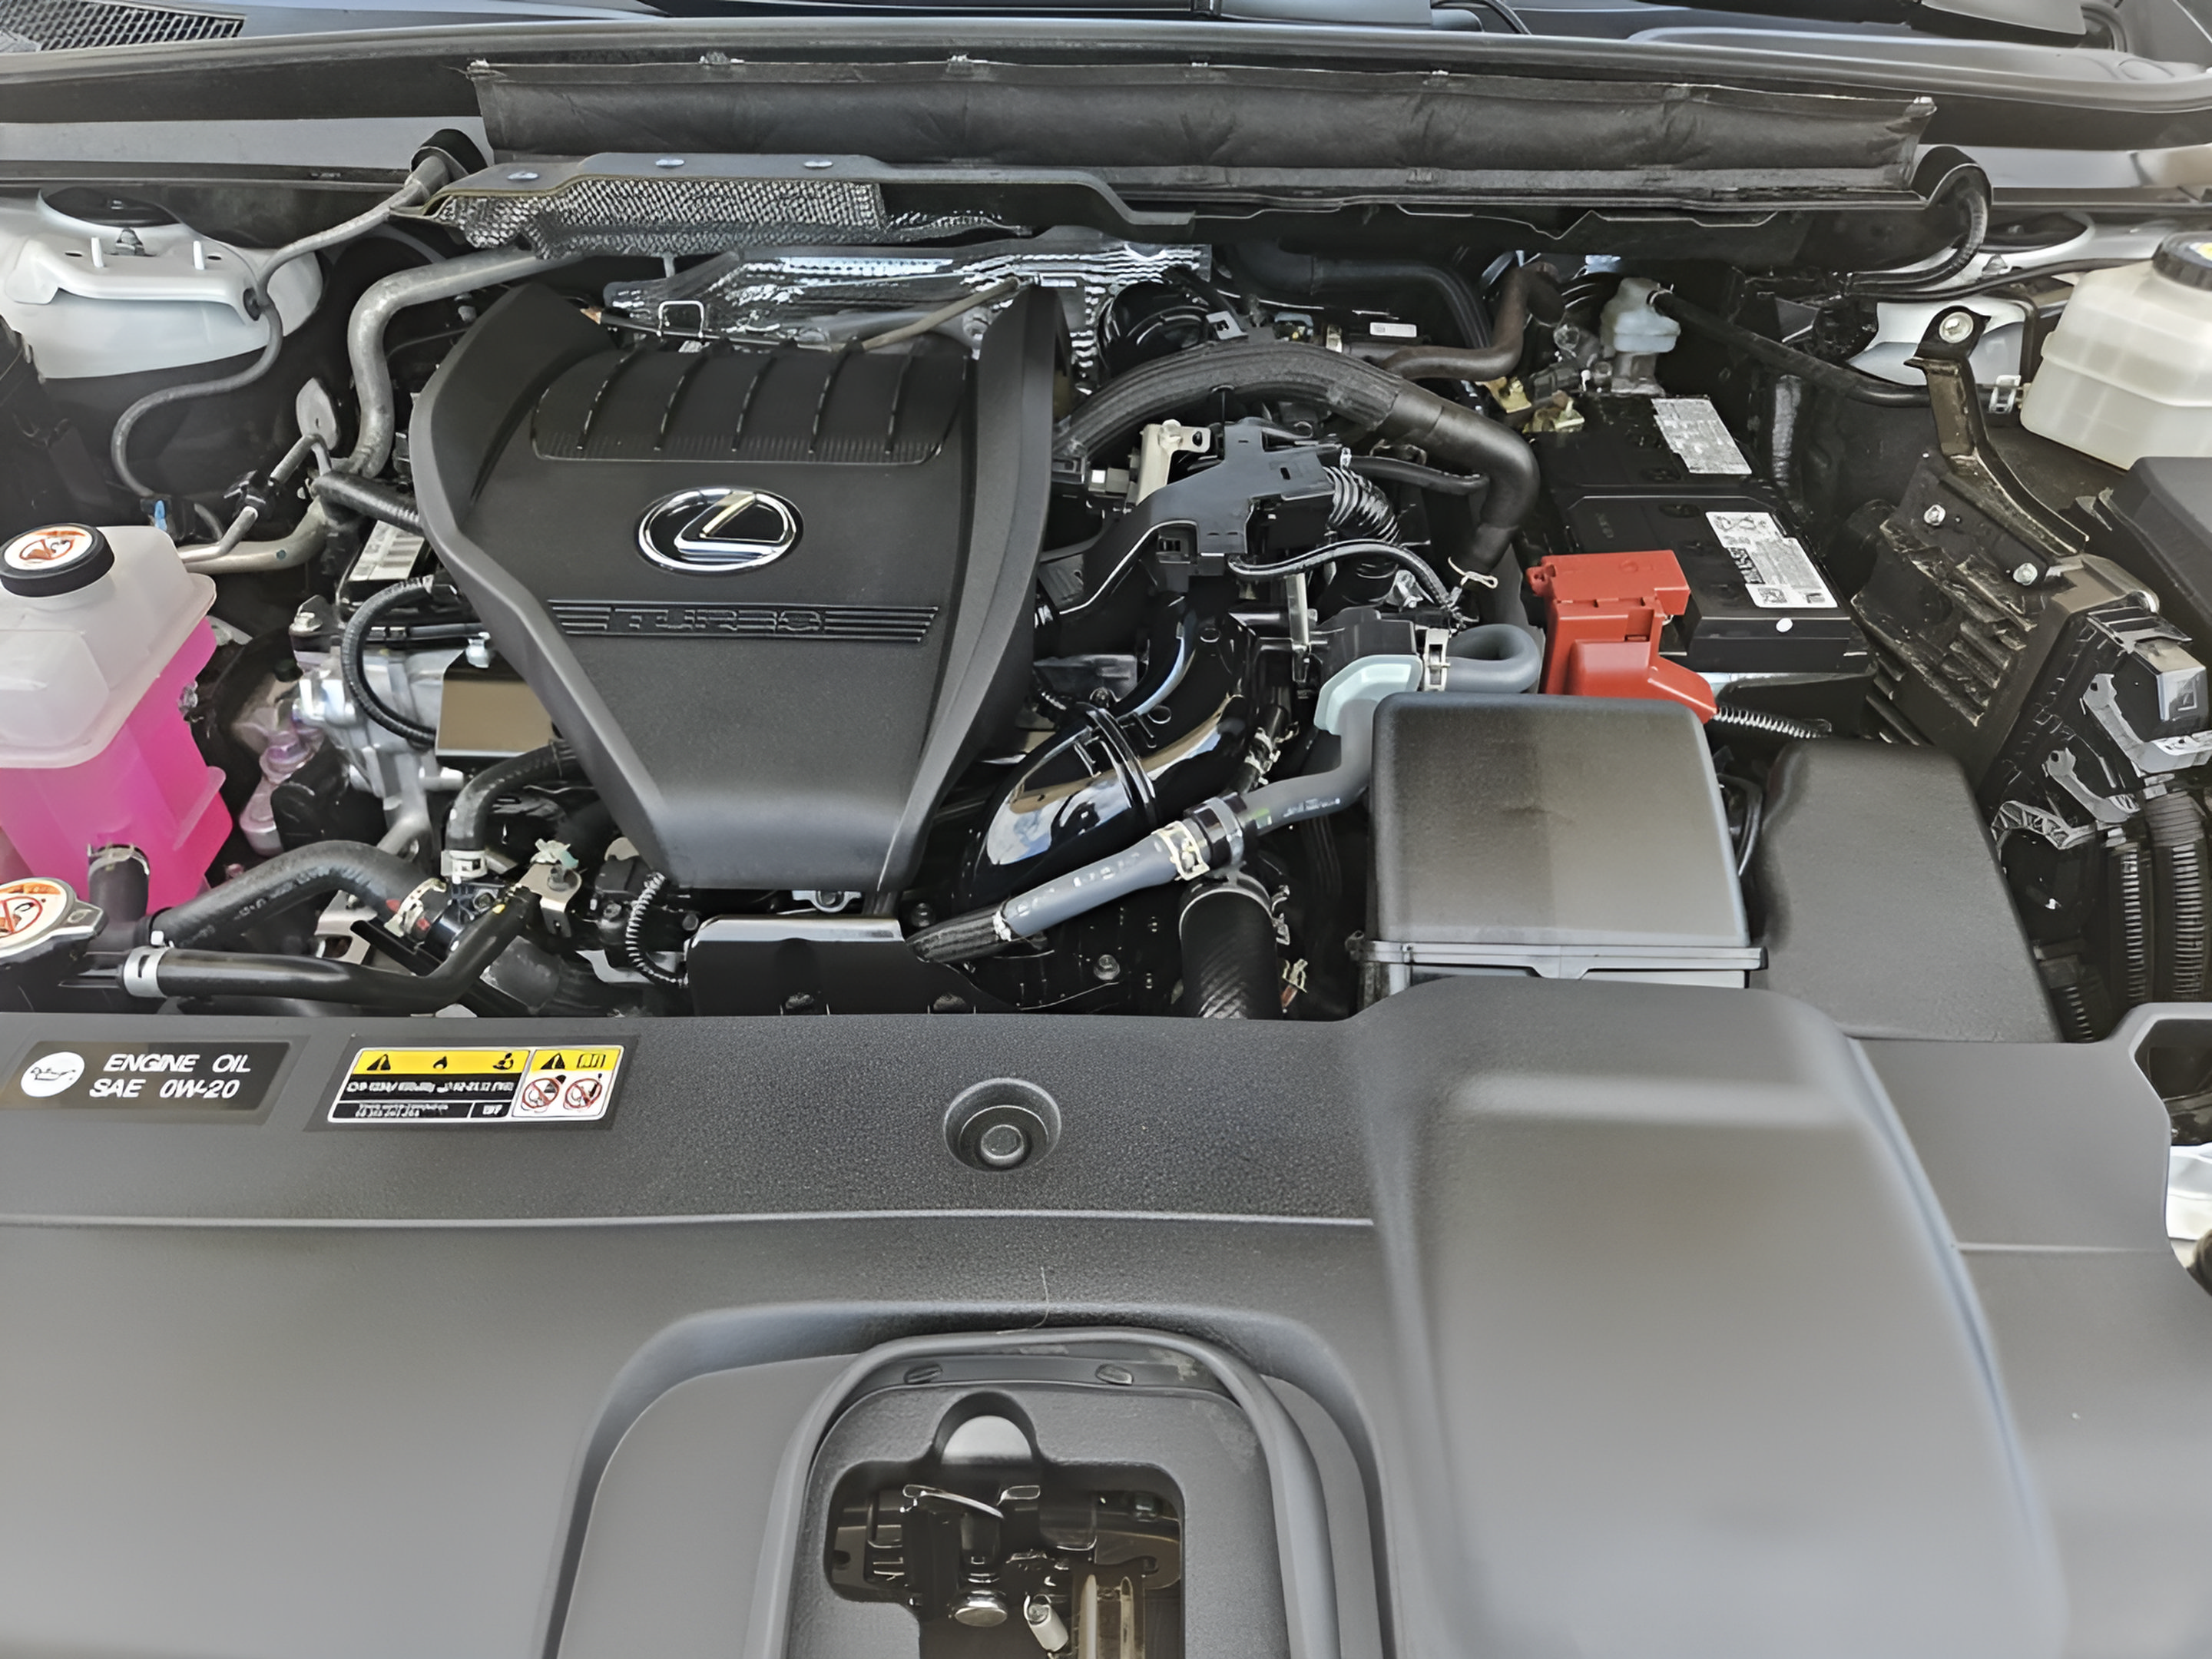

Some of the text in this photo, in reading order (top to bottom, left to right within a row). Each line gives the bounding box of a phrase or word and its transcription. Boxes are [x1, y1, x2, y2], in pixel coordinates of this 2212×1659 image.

[614, 608, 822, 632] TURBO
[103, 1053, 251, 1073] ENGINE OIL
[89, 1078, 240, 1099] SAE 0W-20
